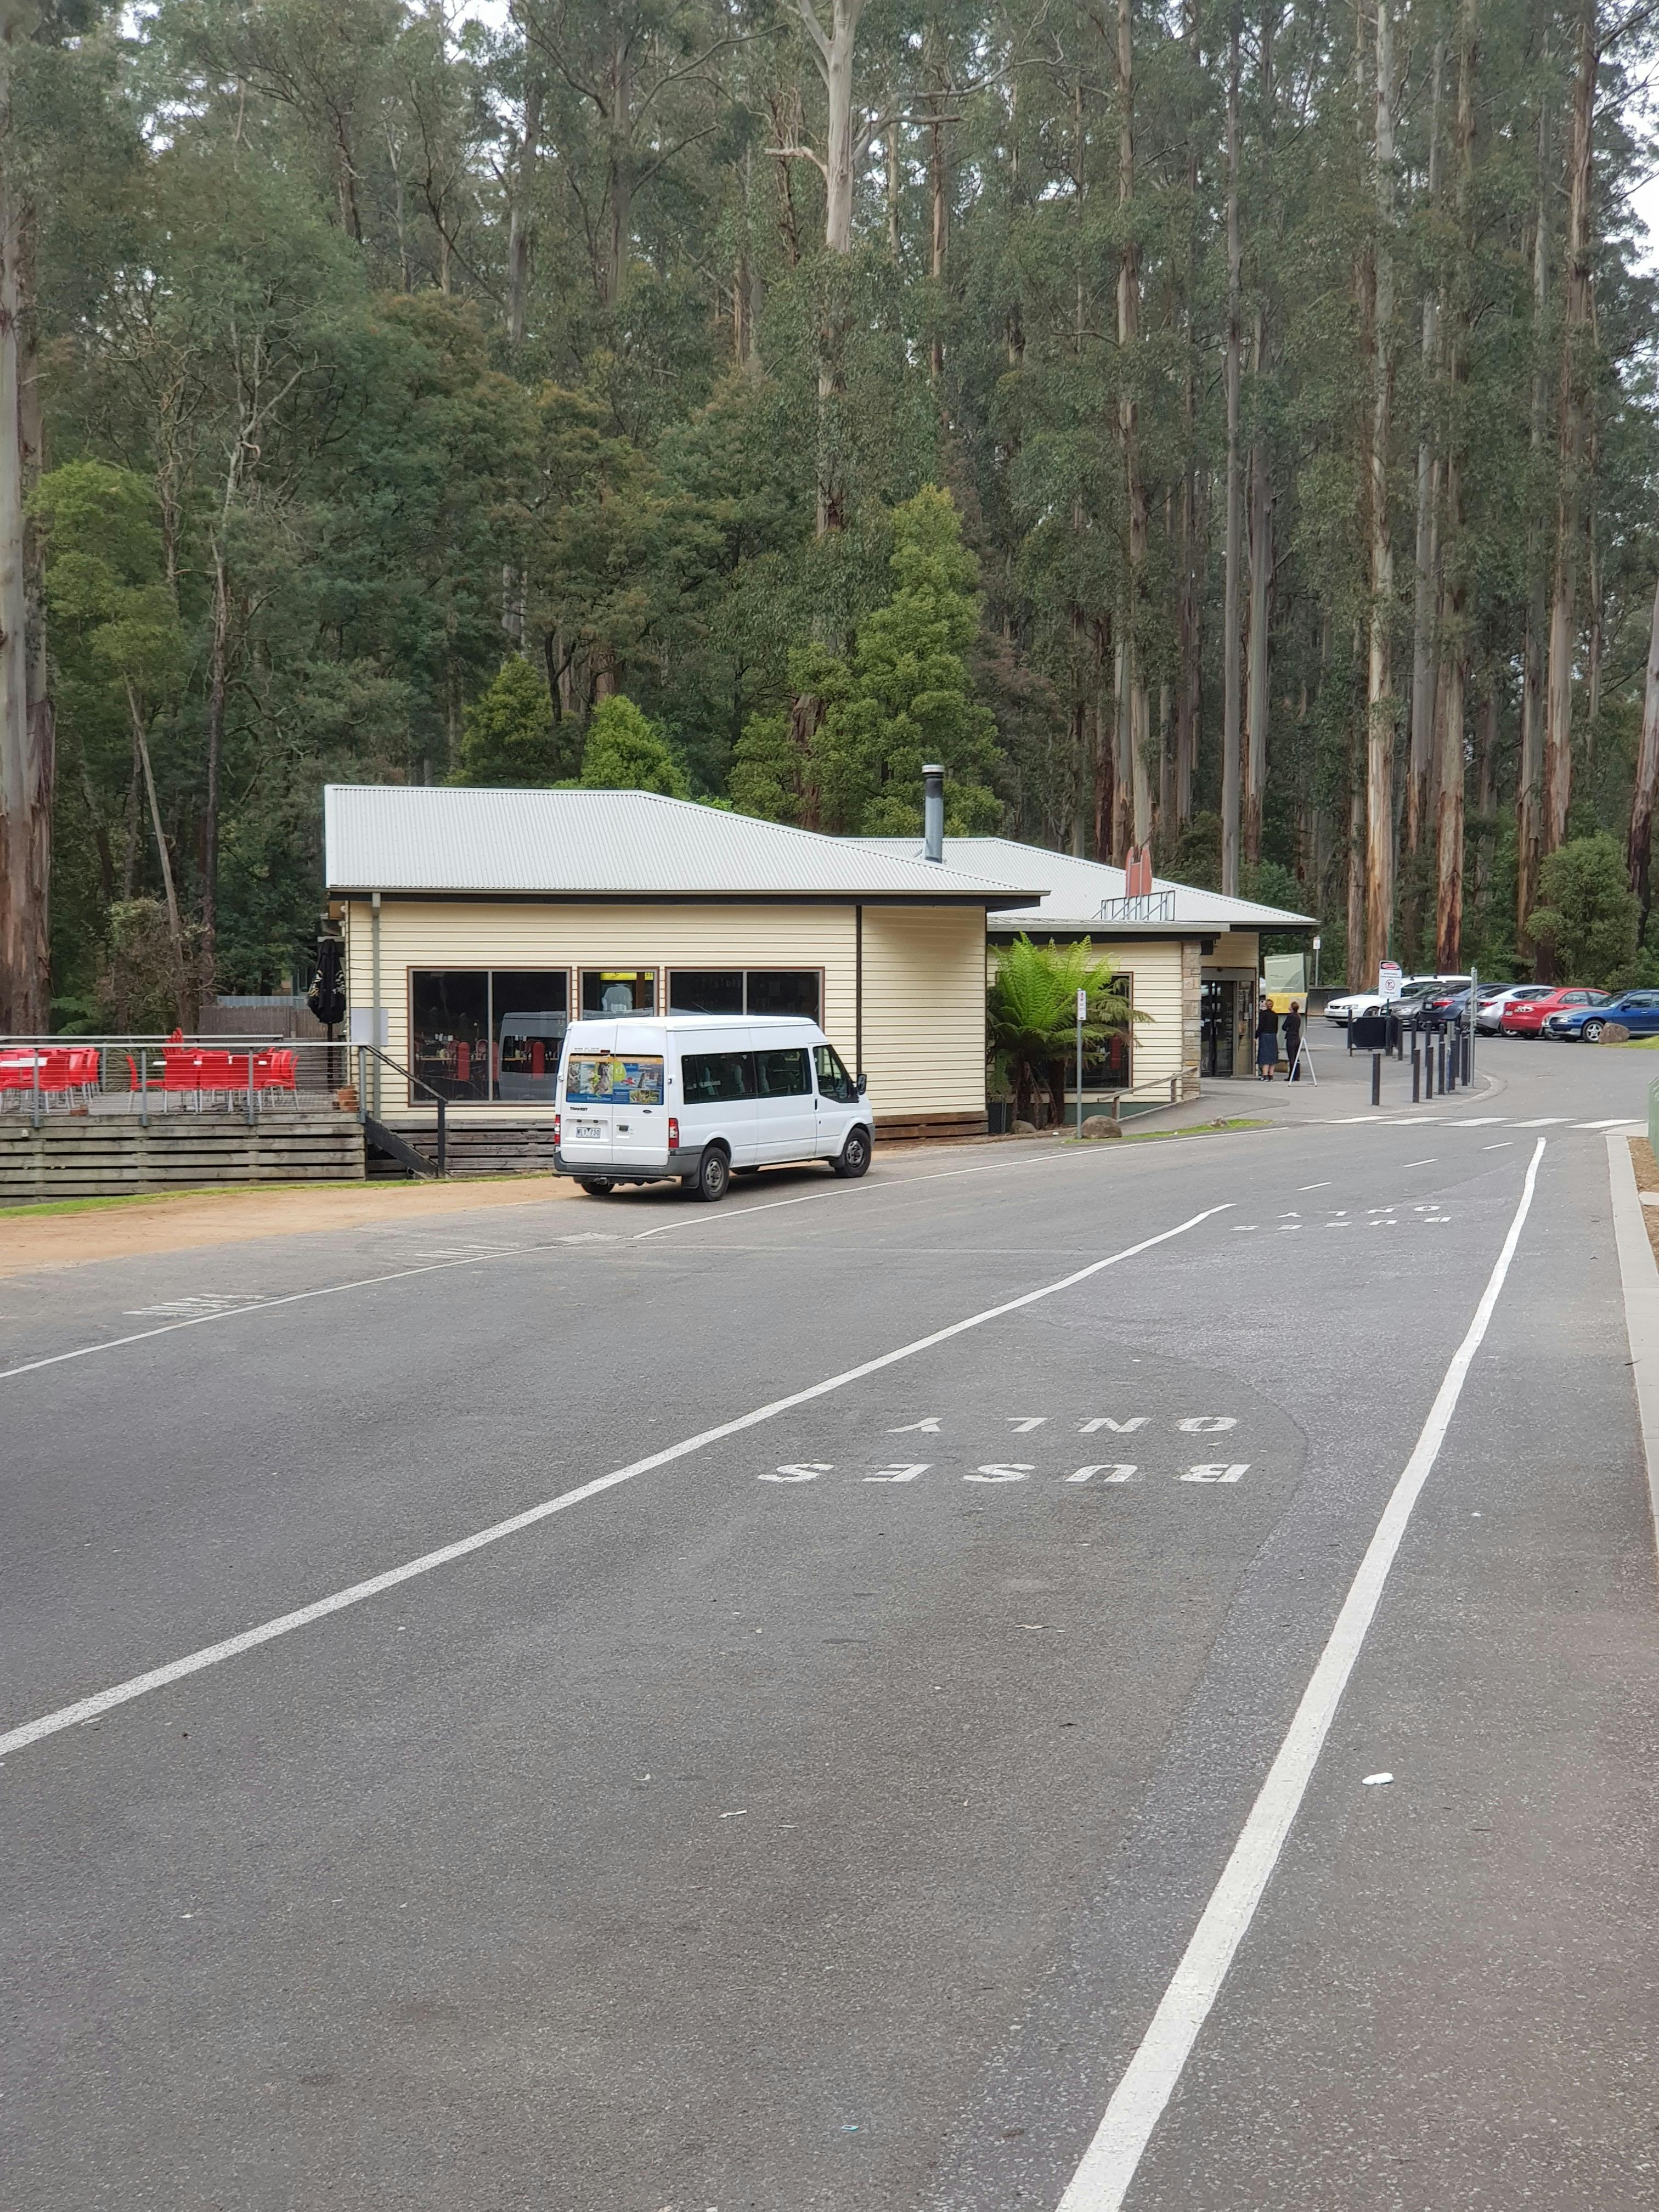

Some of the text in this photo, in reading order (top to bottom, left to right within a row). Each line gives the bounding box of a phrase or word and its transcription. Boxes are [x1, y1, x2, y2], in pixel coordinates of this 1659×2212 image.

[1277, 1205, 1441, 1218] ONLY
[884, 1417, 1238, 1433] ONLY
[757, 1463, 1252, 1482] BUSES
